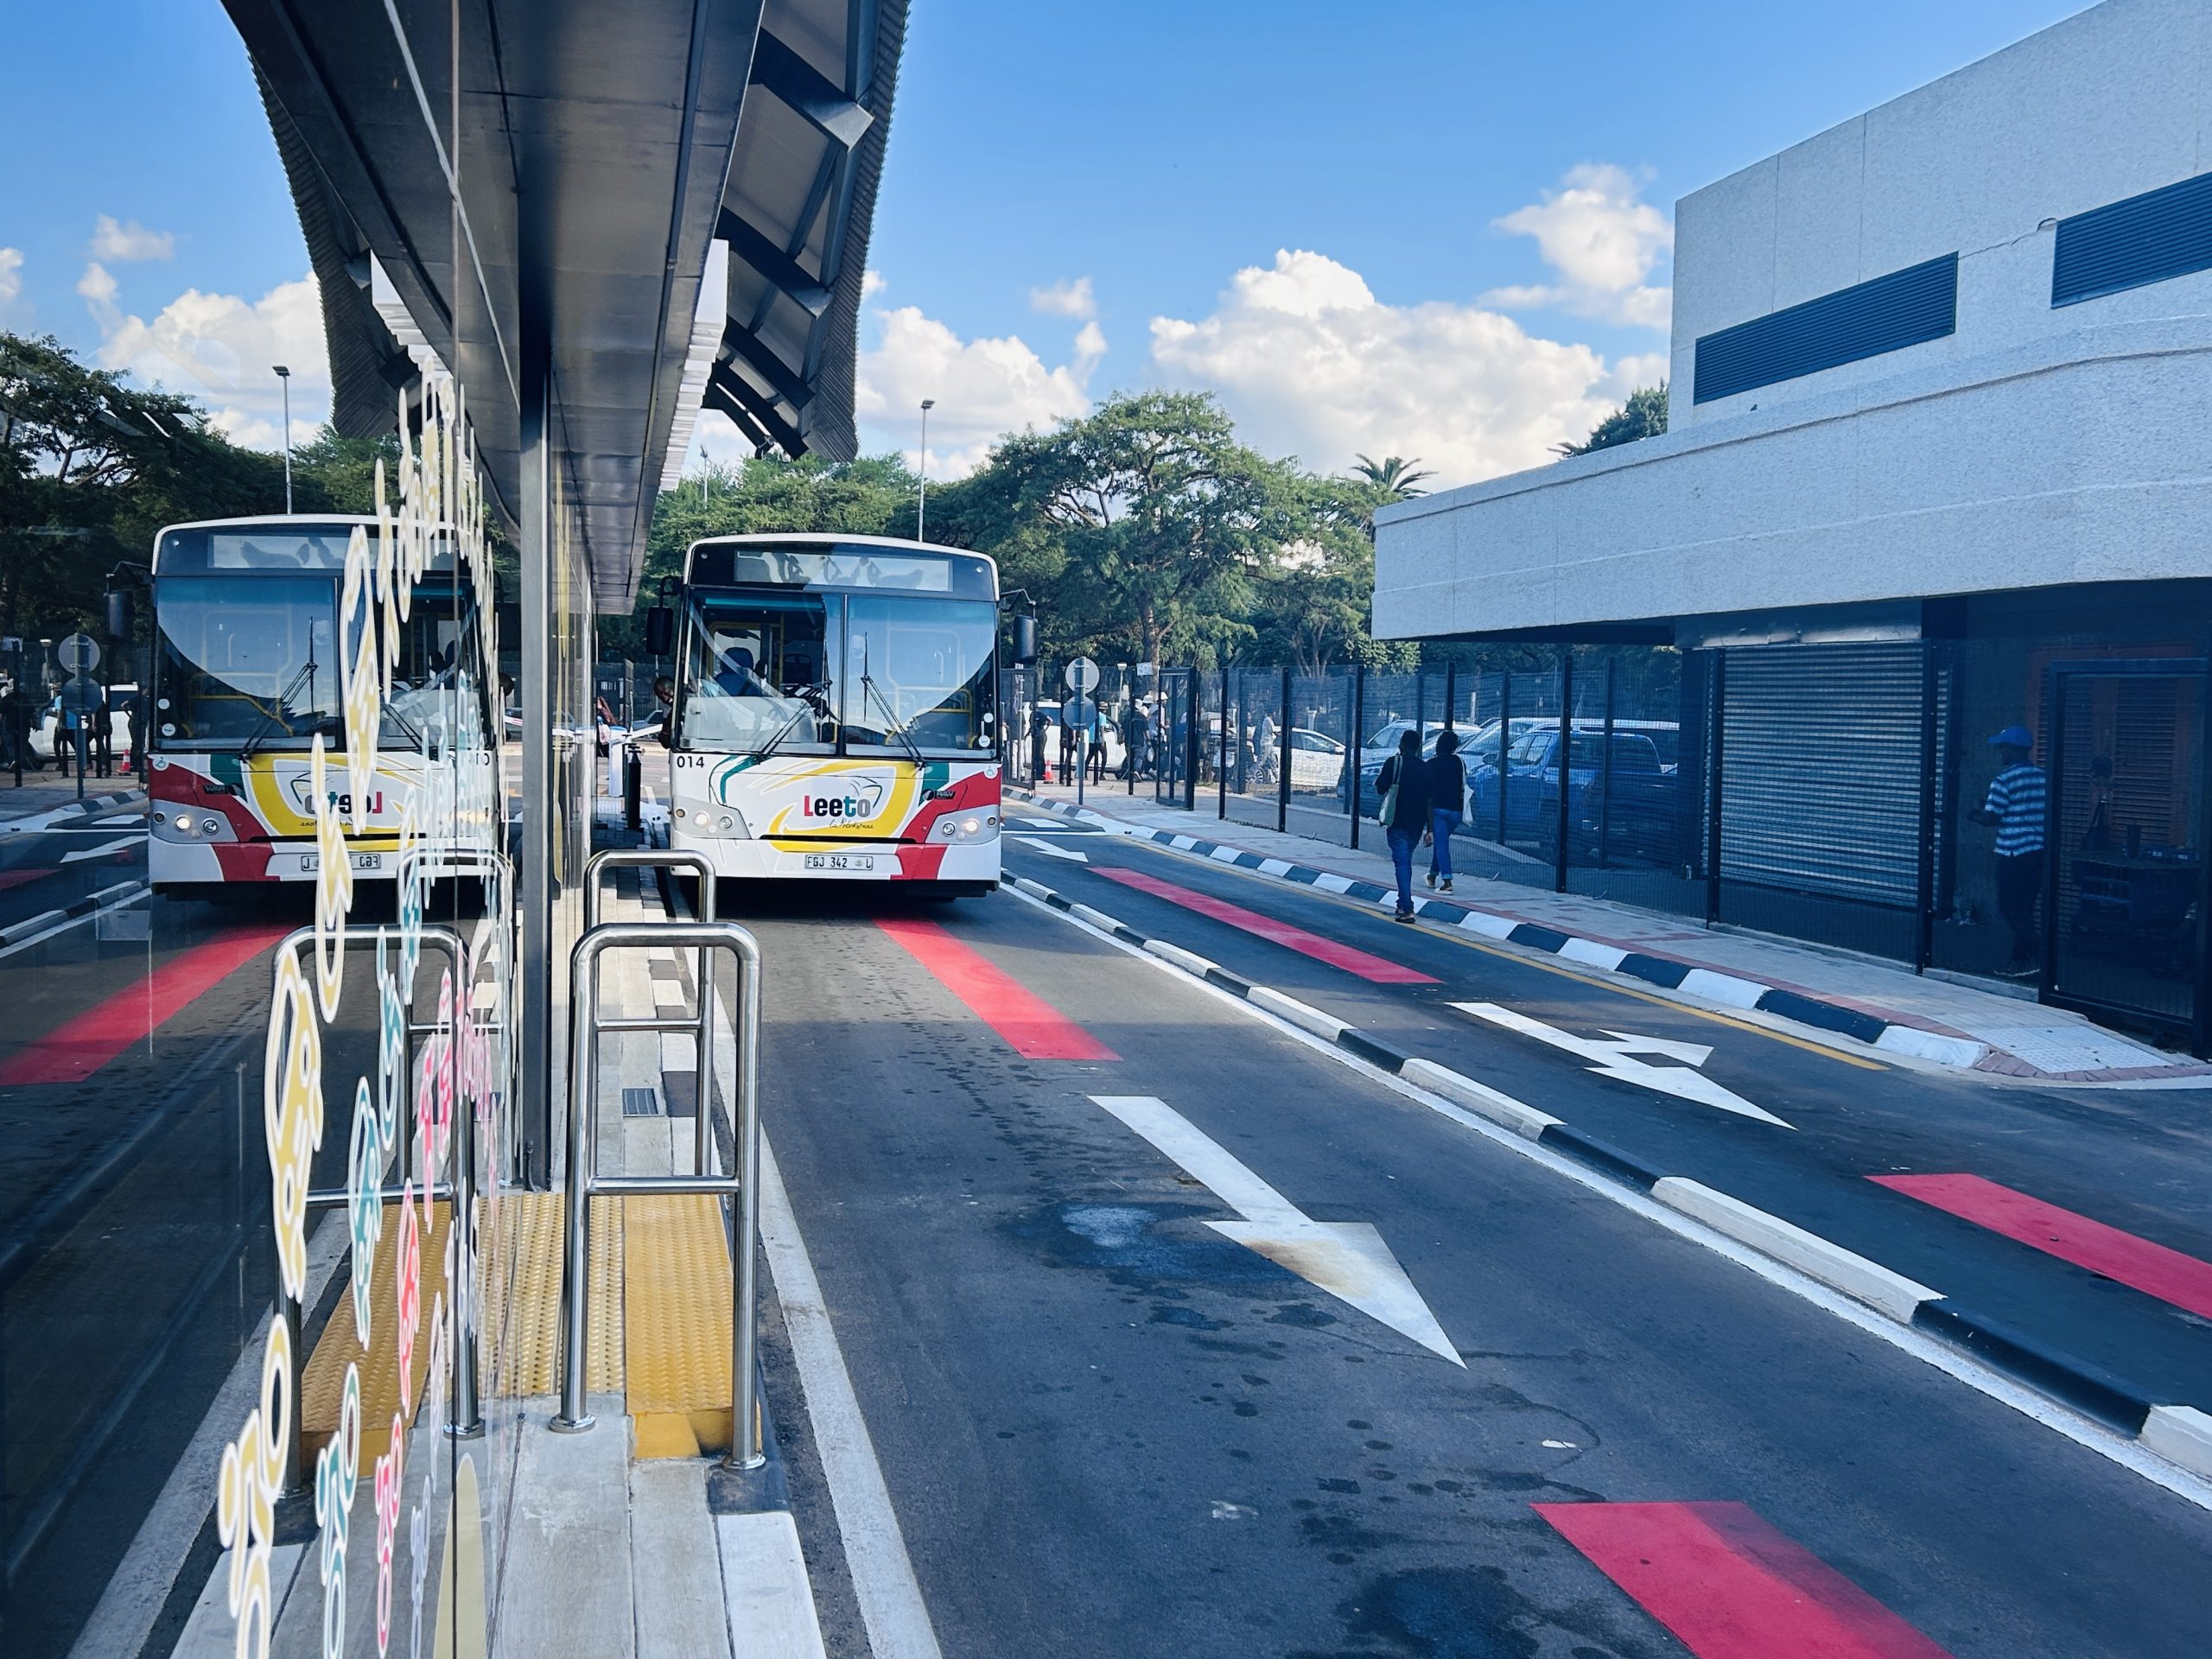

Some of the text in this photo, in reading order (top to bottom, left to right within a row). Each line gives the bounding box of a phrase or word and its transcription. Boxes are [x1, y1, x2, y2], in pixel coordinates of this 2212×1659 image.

[677, 755, 704, 768] 014
[804, 795, 871, 817] Leeto
[807, 856, 872, 868] FGJ 342 L
